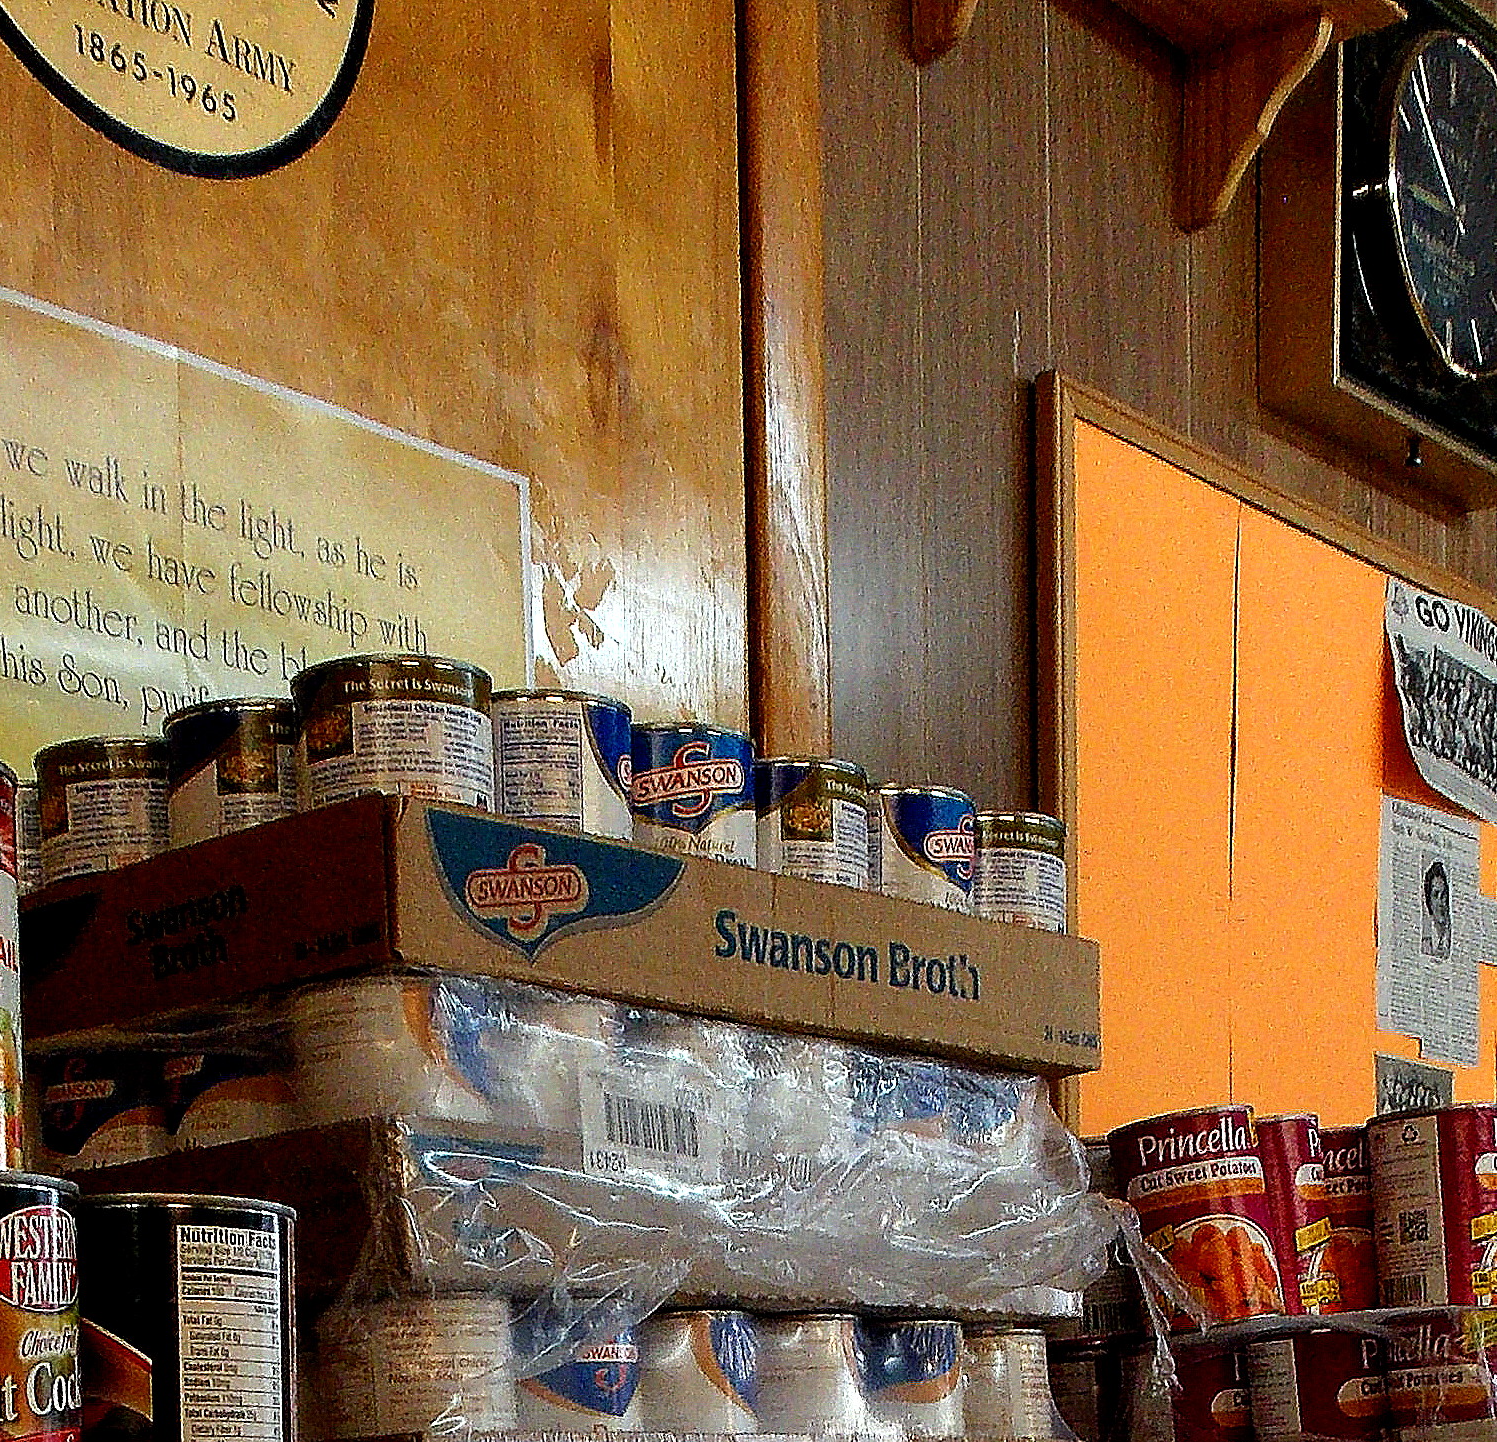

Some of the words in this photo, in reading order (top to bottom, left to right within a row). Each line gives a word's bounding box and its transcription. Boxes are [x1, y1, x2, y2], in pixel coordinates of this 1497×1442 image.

[74, 24, 238, 122] 1865-1965
[205, 19, 295, 94] ARMY
[3, 439, 48, 477] we
[66, 457, 128, 503] walk
[142, 472, 167, 513] in
[181, 484, 226, 531] the
[241, 500, 305, 559] light,
[318, 537, 345, 564] as
[357, 538, 386, 580] he
[400, 553, 418, 588] is
[2, 499, 75, 560] light,
[91, 536, 133, 571] we
[148, 539, 215, 594] have
[229, 564, 367, 643] fellowship
[378, 617, 428, 654] with
[16, 585, 142, 647] another,
[156, 620, 210, 661] and
[222, 631, 268, 677] the
[1415, 595, 1450, 633] GO
[2, 637, 45, 685] his
[59, 653, 128, 709] Son,
[345, 680, 366, 692] The
[369, 679, 409, 691] Secret
[638, 764, 738, 798] SWANSON
[478, 870, 572, 900] SWANSON
[126, 886, 248, 943] Swanson
[152, 934, 228, 978] Broth
[715, 911, 879, 982] Swanson
[888, 941, 981, 1001] Broth
[1139, 1117, 1247, 1166] Princella
[1141, 1175, 1162, 1193] Cut
[1165, 1168, 1207, 1189] Sweet
[1211, 1162, 1257, 1180] Potatoes
[181, 1228, 244, 1246] Nutrition
[247, 1231, 276, 1248] Facts
